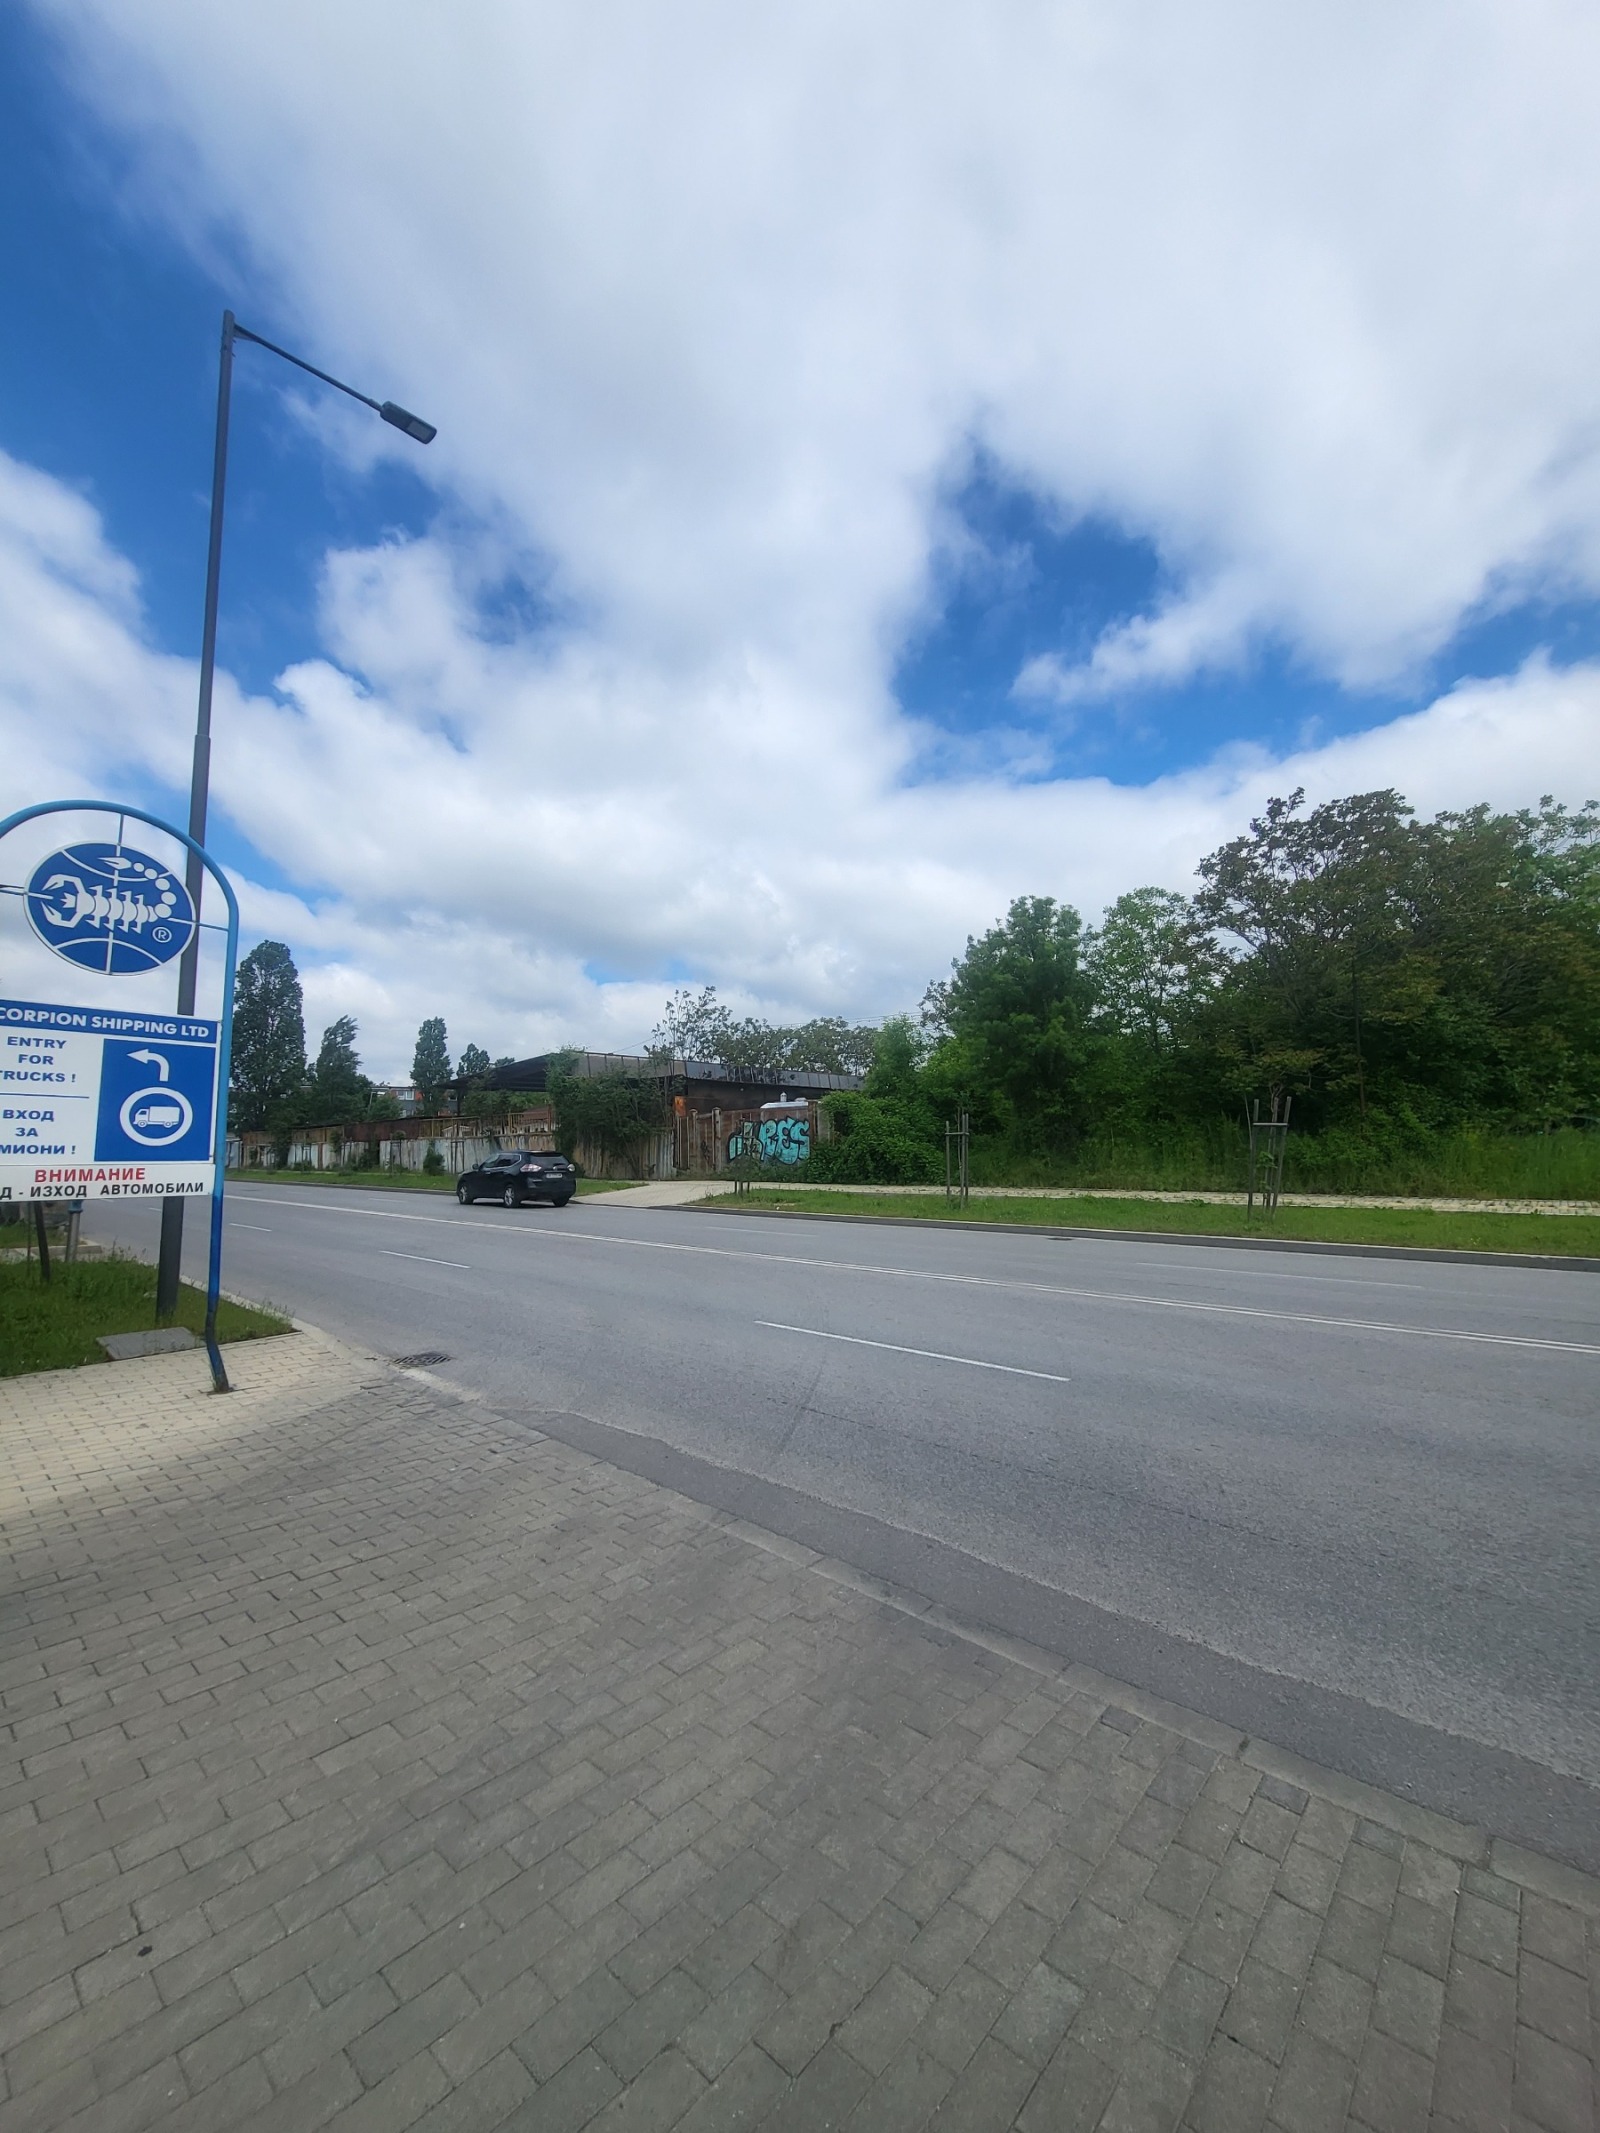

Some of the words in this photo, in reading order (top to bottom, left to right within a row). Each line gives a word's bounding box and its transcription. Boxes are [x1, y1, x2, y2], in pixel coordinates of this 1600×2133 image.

[91, 1016, 177, 1035] SHIPPING
[181, 1025, 209, 1038] LTD
[7, 1036, 67, 1049] ENTRY
[18, 1054, 54, 1065] FOR
[0, 1070, 66, 1082] RUCKS
[71, 1074, 76, 1083] !
[3, 1109, 55, 1122] ВХОД
[15, 1127, 38, 1137] ЗА
[0, 1144, 66, 1155] МИОНИ
[71, 1145, 76, 1155] !
[35, 1167, 146, 1182] ВНИМАНИЕ
[30, 1185, 88, 1198] ИЗХОД
[100, 1182, 204, 1196] АВТОМОБИЛИ
